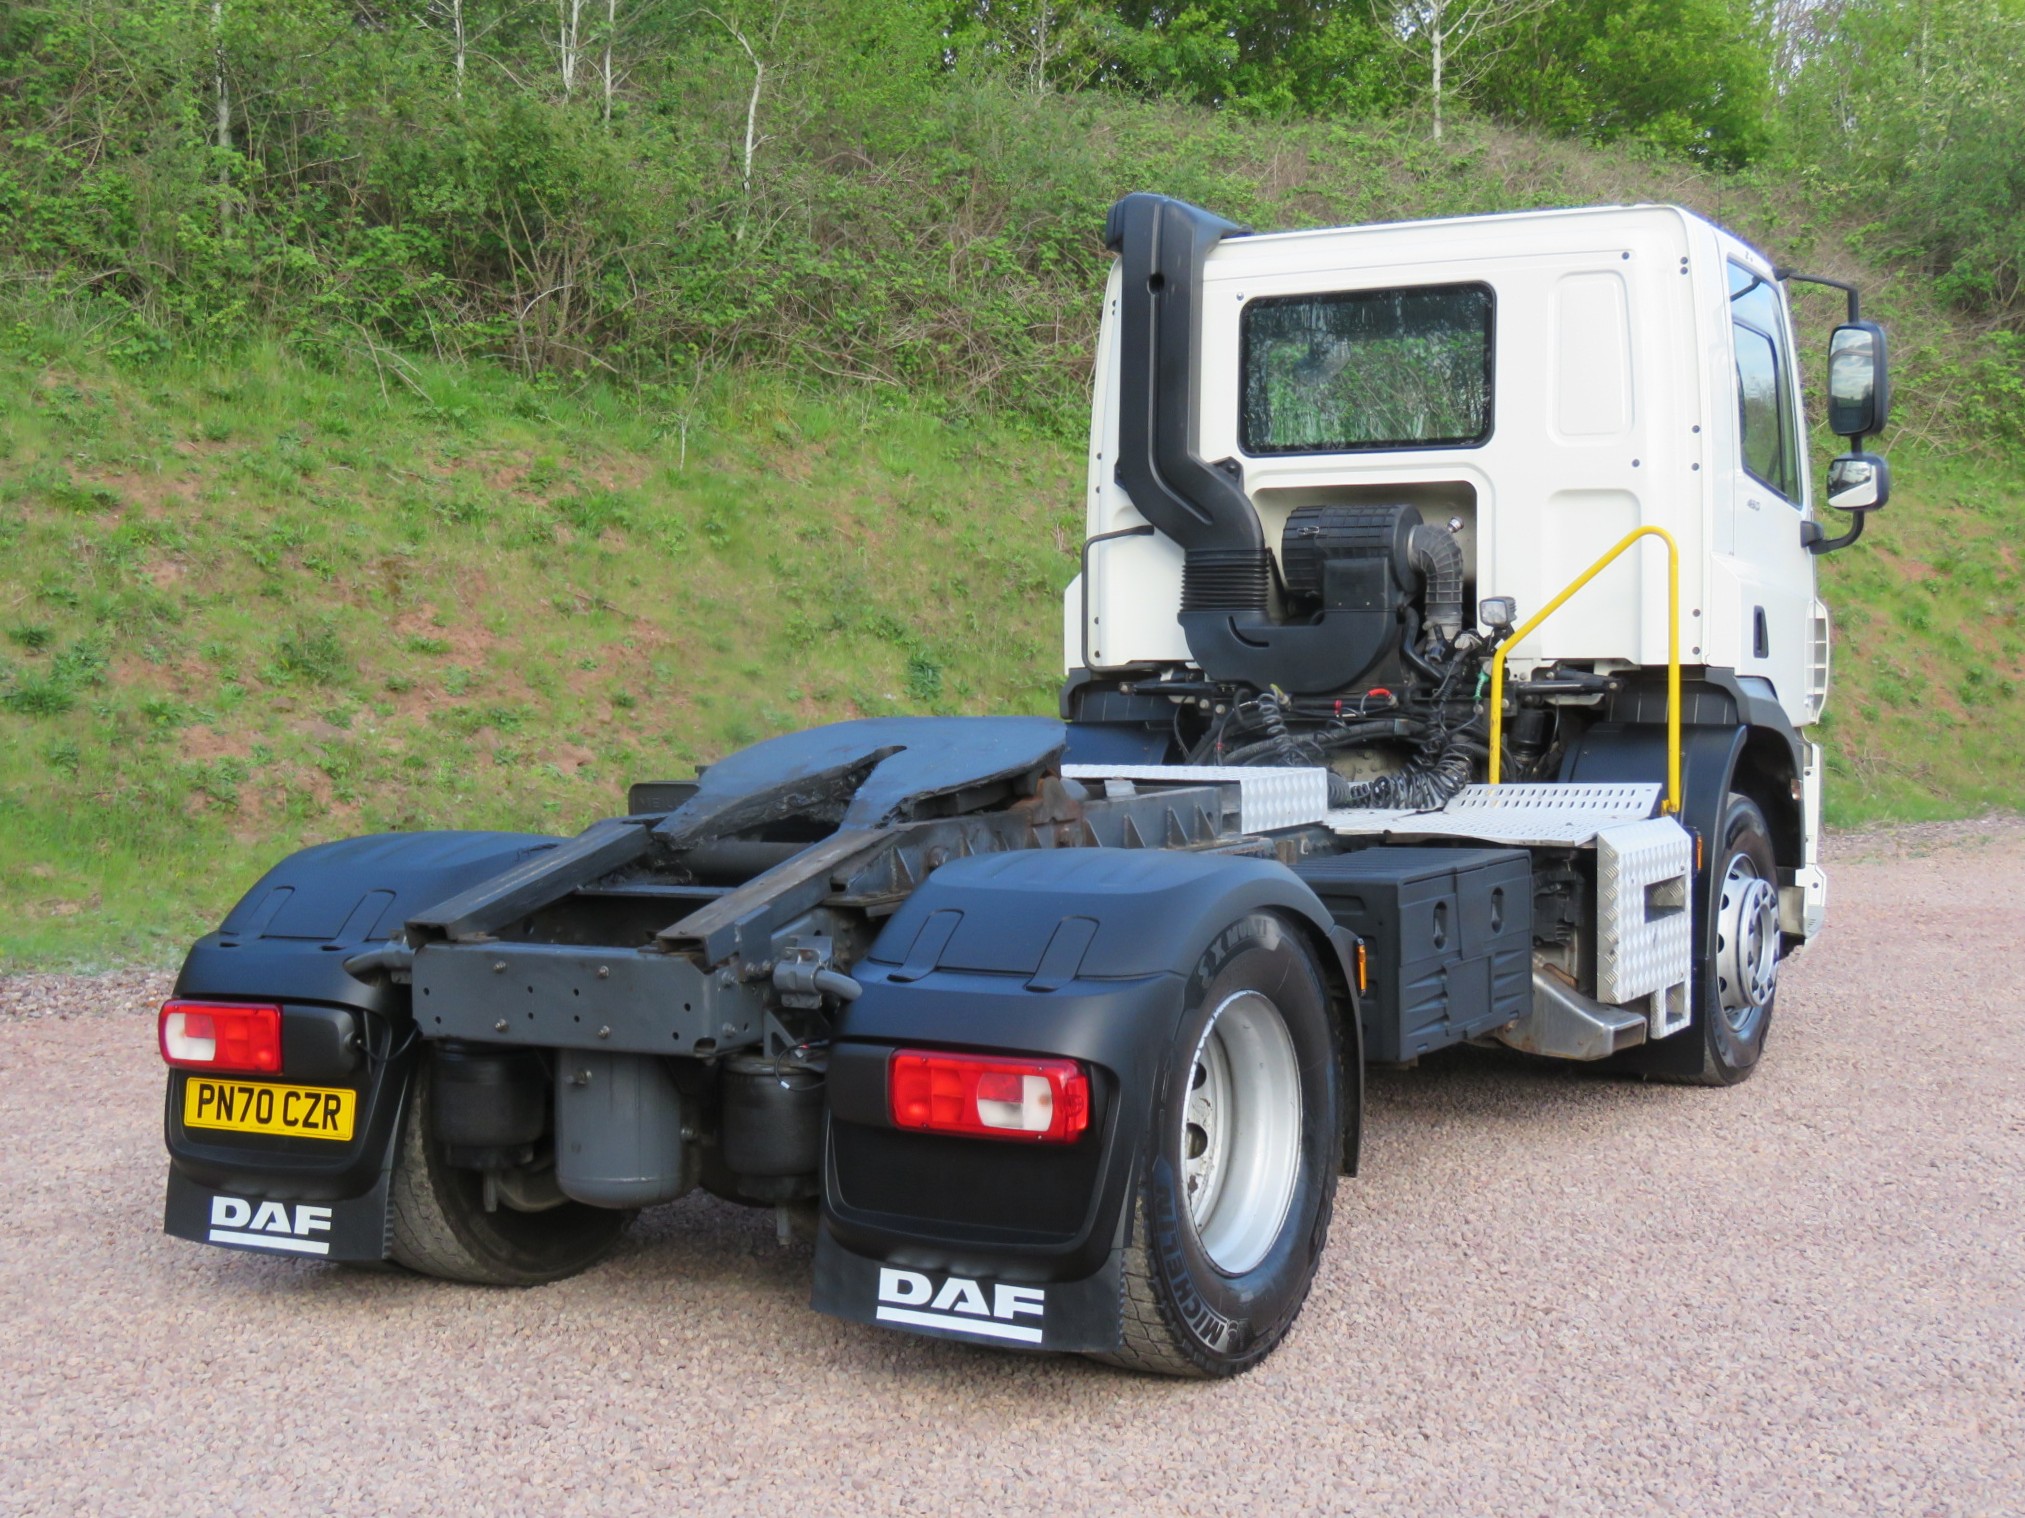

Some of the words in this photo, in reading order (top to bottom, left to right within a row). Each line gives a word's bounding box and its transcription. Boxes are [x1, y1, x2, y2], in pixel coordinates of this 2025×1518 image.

[197, 1083, 274, 1124] PN70
[283, 1091, 342, 1131] CZR
[211, 1195, 333, 1236] DAF
[1155, 1185, 1226, 1347] MICHELIN
[878, 1266, 1045, 1320] DAF
